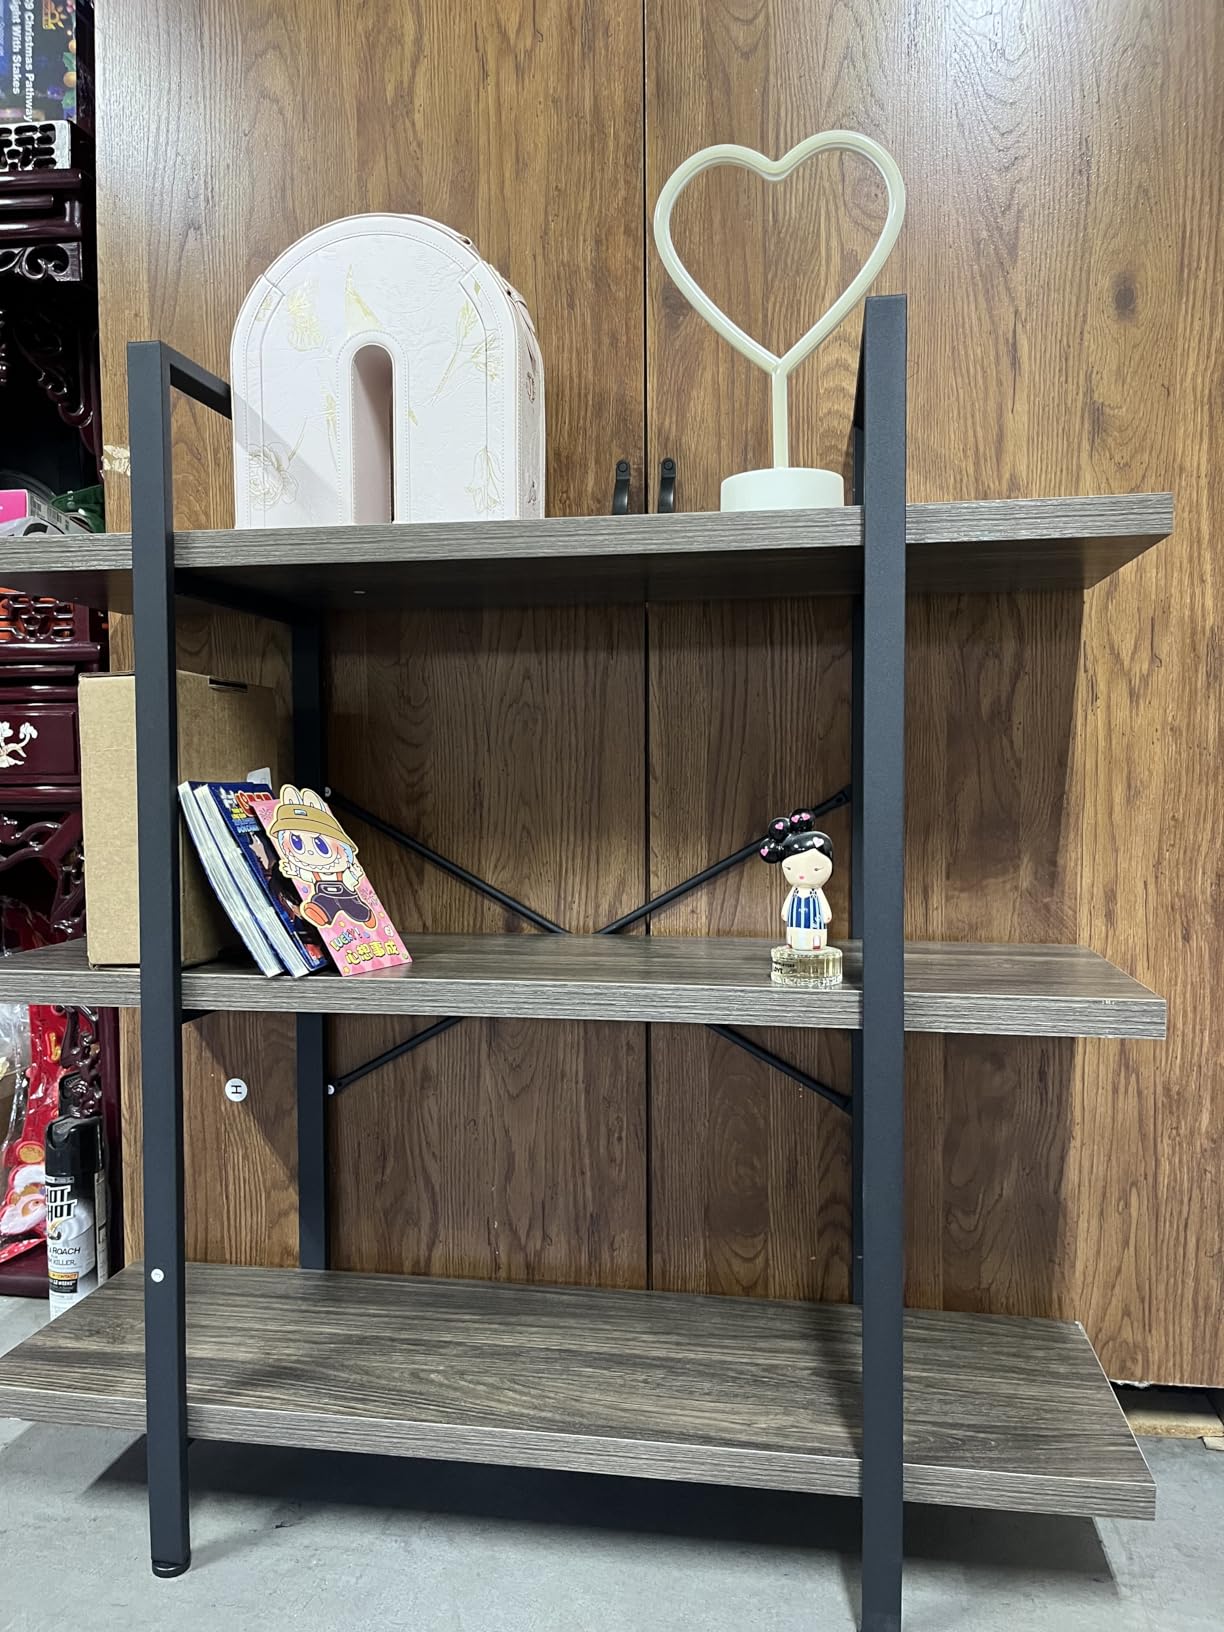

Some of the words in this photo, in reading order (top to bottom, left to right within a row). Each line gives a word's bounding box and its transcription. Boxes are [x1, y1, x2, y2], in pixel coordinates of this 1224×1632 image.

[9, 0, 22, 23] ight
[12, 25, 22, 52] With
[24, 11, 35, 71] Christmas
[12, 54, 22, 95] Stakes
[23, 73, 35, 122] Pathway
[53, 1246, 81, 1255] ROACH
